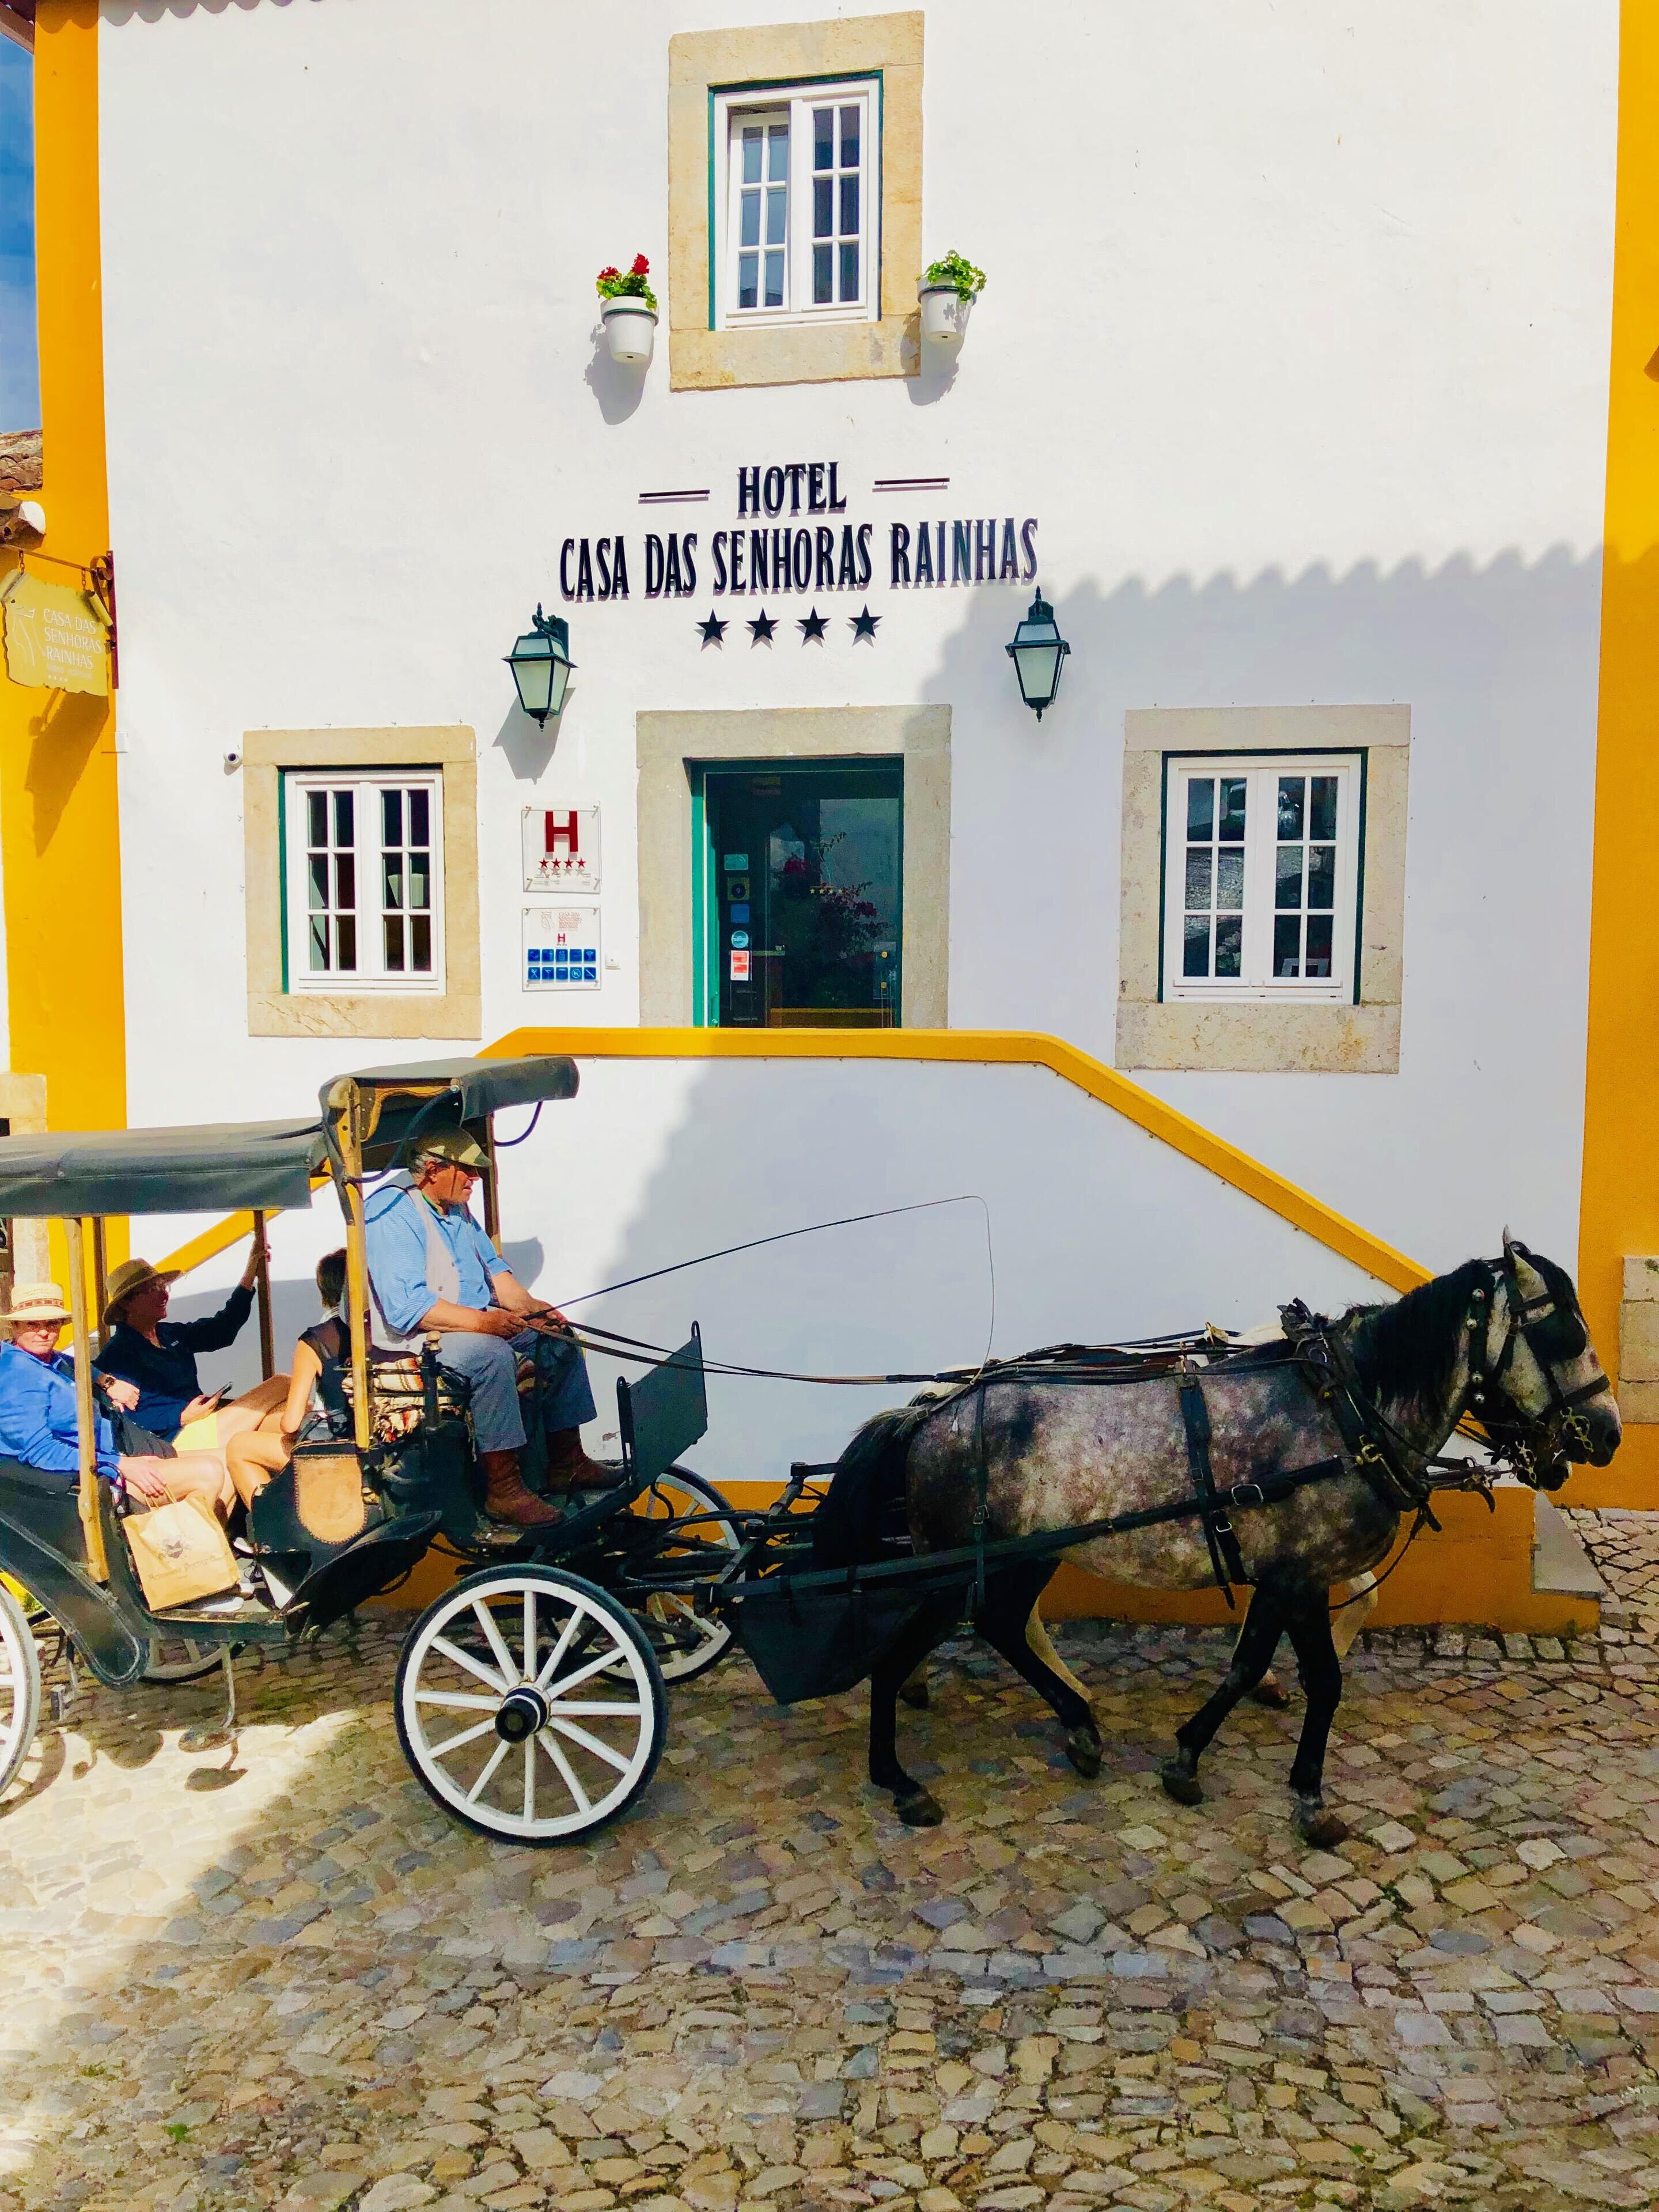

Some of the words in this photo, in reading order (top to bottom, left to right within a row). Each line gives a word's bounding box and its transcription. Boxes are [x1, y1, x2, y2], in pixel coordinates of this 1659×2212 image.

[738, 462, 847, 513] HOTEL
[560, 536, 630, 597] CASA
[646, 533, 698, 594] DAS
[713, 523, 873, 591] SENHORAS
[890, 518, 1038, 584] RAINHAS
[44, 609, 71, 627] CASA
[75, 617, 96, 634] DAS
[45, 628, 101, 653] SENHORAS
[47, 646, 93, 669] RAINHAS
[545, 810, 578, 853] H
[558, 933, 566, 942] H
